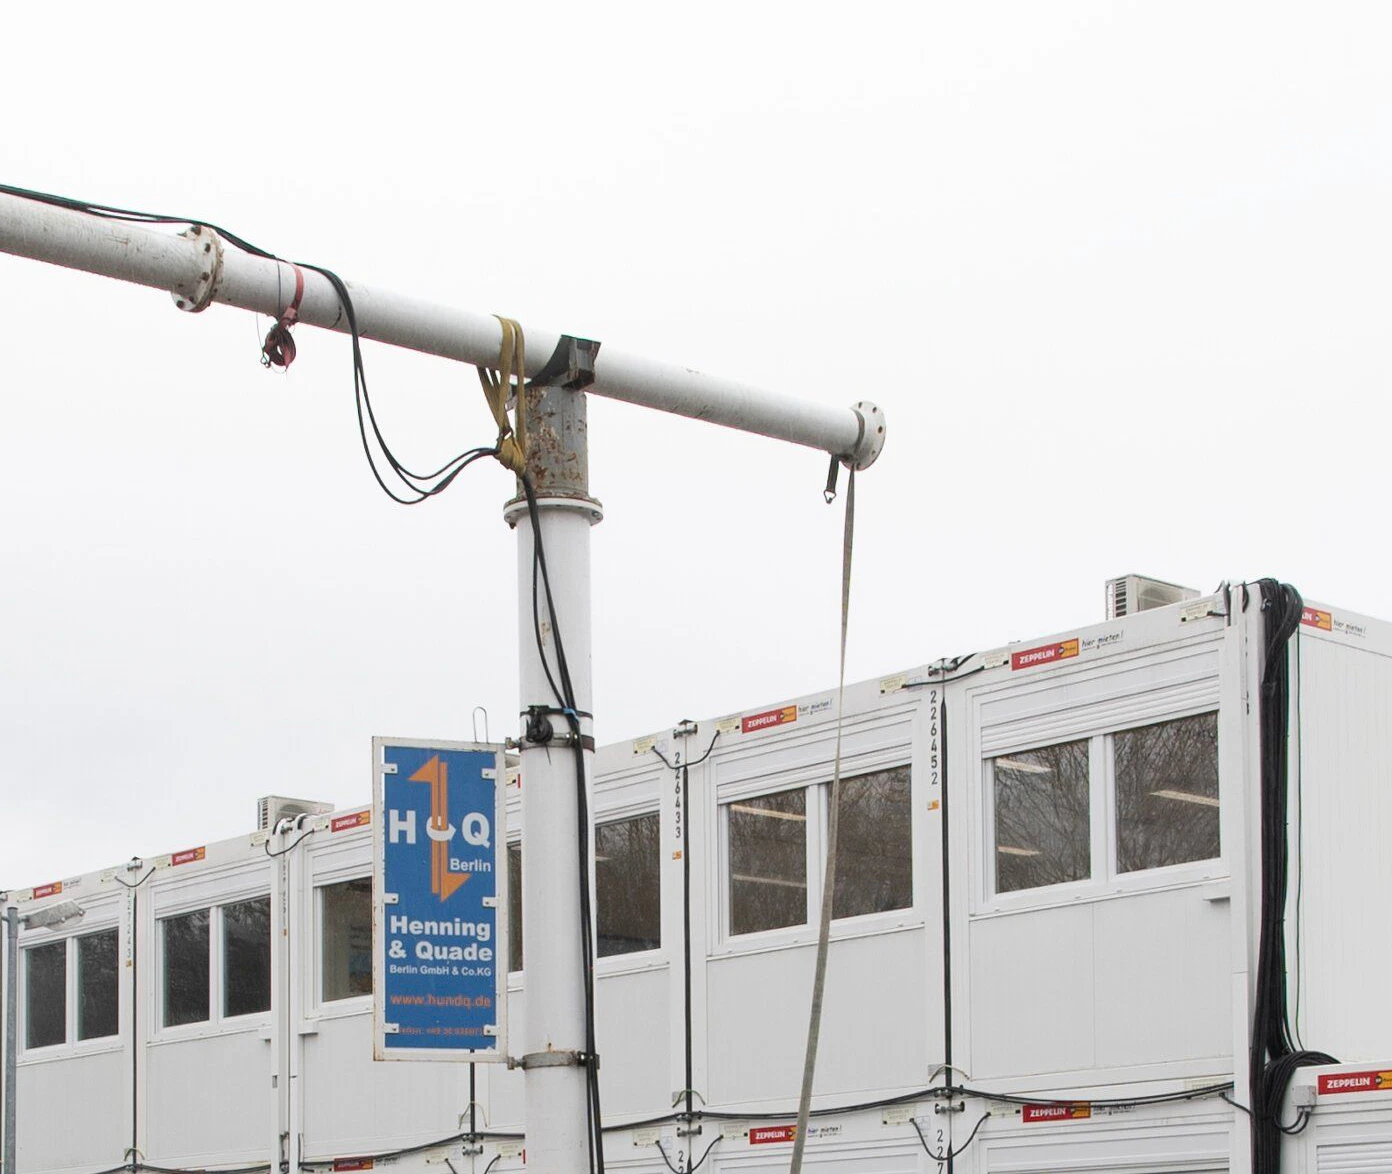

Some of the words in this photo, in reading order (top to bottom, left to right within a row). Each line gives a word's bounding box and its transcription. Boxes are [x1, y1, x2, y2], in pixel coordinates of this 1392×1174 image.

[1019, 649, 1055, 664] ZEPPELIN
[748, 714, 777, 728] ZEPPELIN
[930, 690, 938, 785] 226452
[674, 752, 682, 839] 226433
[450, 858, 491, 872] Berlin
[390, 915, 490, 941] Henning
[388, 940, 407, 959] &
[415, 941, 492, 962] Quade
[390, 964, 417, 974] Berlin
[420, 965, 449, 975] GmbH
[452, 966, 459, 975] &
[461, 966, 492, 977] Co.KG
[390, 994, 491, 1010] www.hundq.de
[1327, 1077, 1370, 1089] ZEPPELIN
[1030, 1107, 1066, 1118] ZEPPELIN
[755, 1130, 785, 1140] ZEPPELIN
